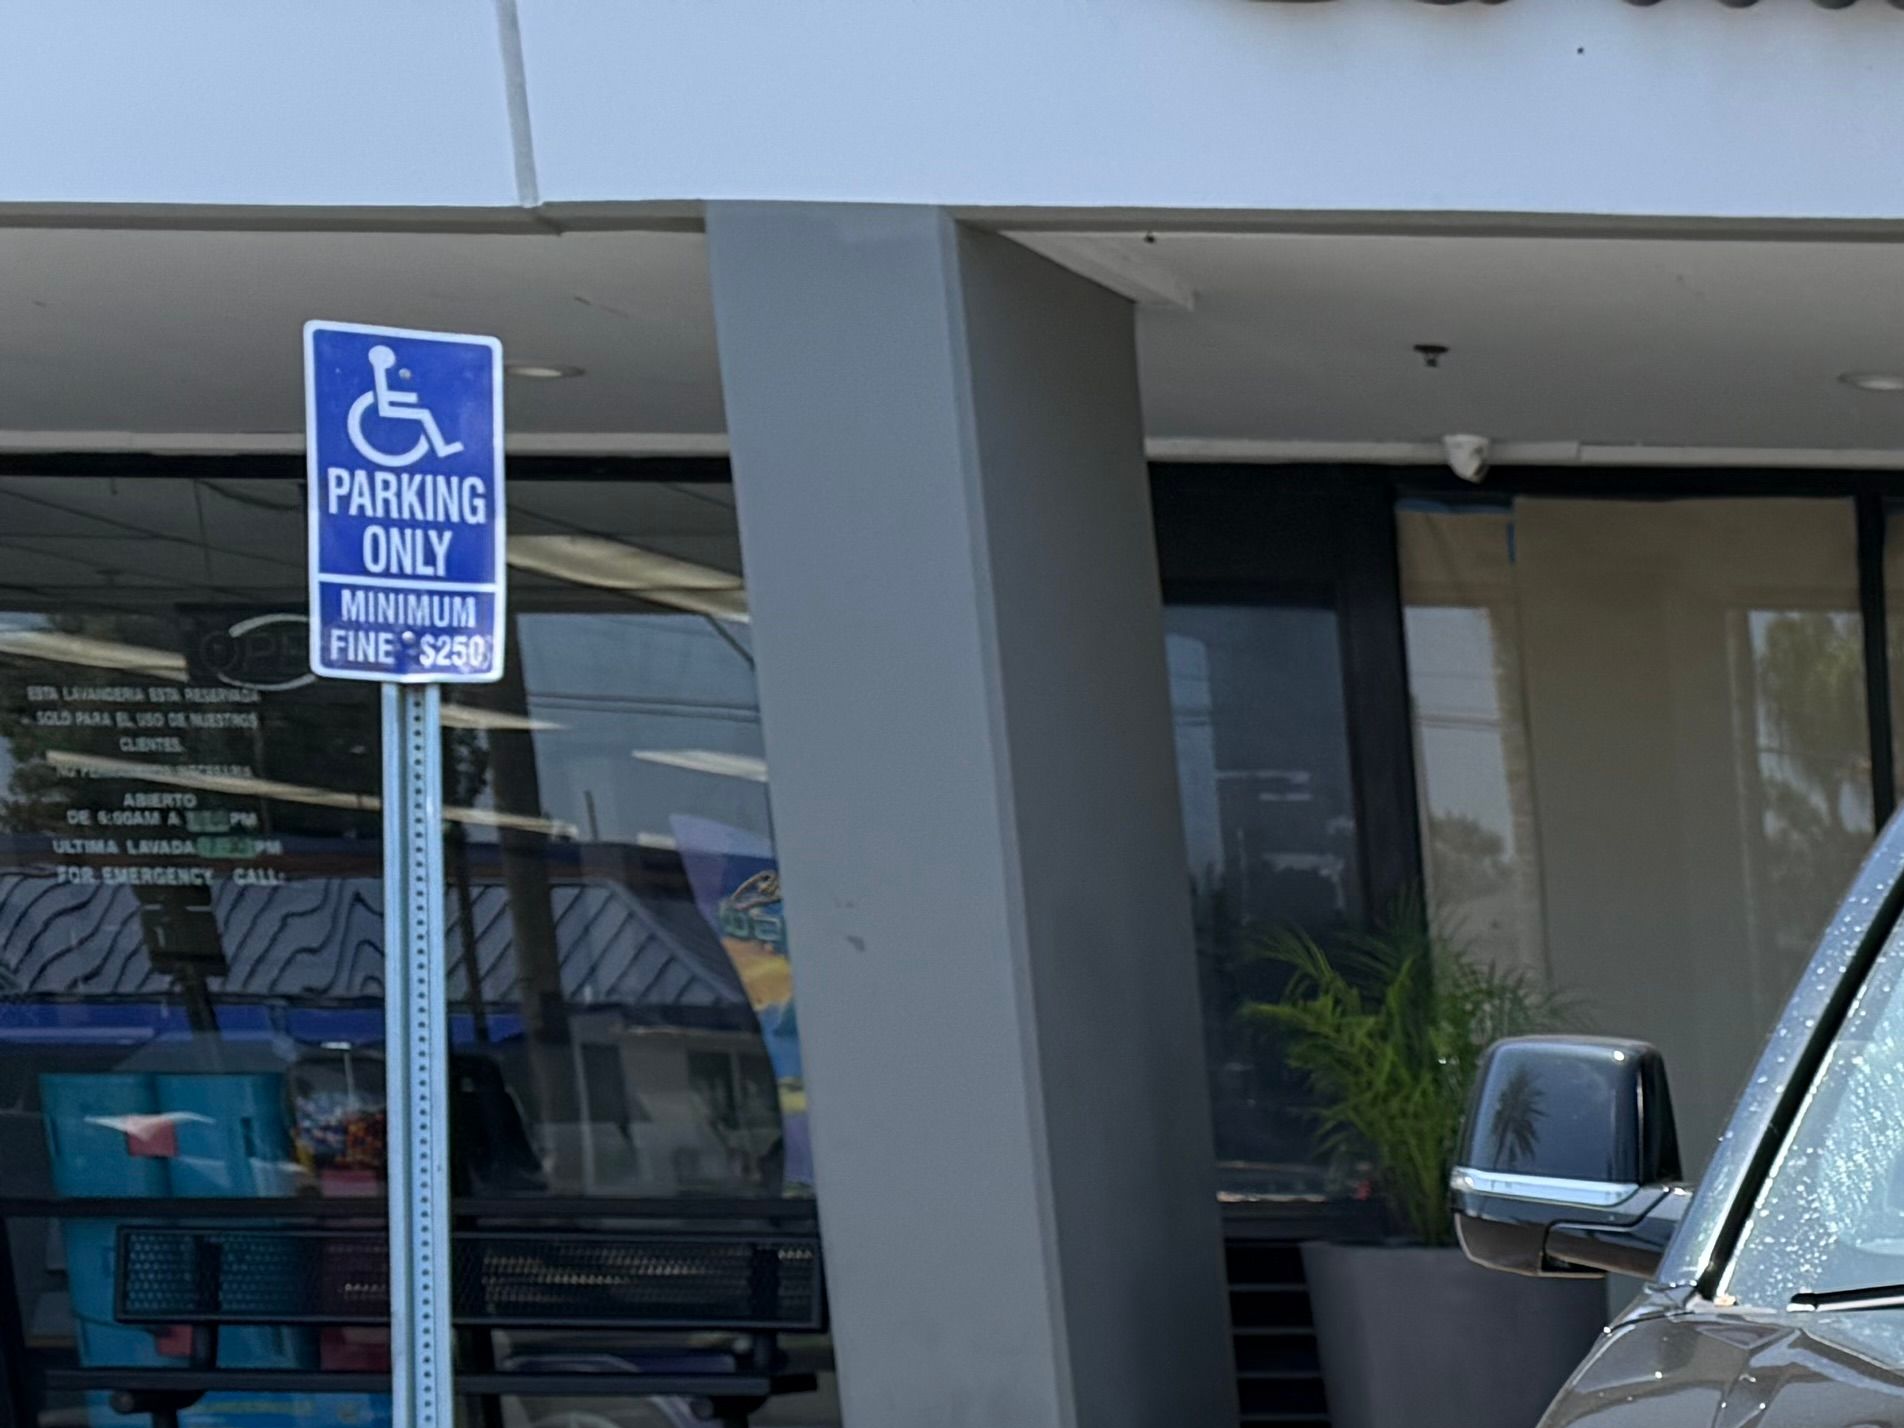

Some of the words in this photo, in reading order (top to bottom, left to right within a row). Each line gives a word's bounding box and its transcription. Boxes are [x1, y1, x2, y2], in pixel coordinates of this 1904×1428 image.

[327, 467, 487, 525] PARKING
[362, 524, 453, 578] ONLY
[340, 588, 477, 628] MINIMUM
[329, 629, 396, 664] FINE
[418, 633, 488, 669] $250
[122, 792, 198, 808] ABIERTO
[66, 809, 91, 825] DE
[167, 811, 181, 826] A
[52, 838, 119, 855] ULTIMA
[125, 839, 196, 856] LAVADA
[255, 840, 283, 856] PM
[56, 866, 97, 884] FOR
[101, 866, 215, 886] EMERGENCY
